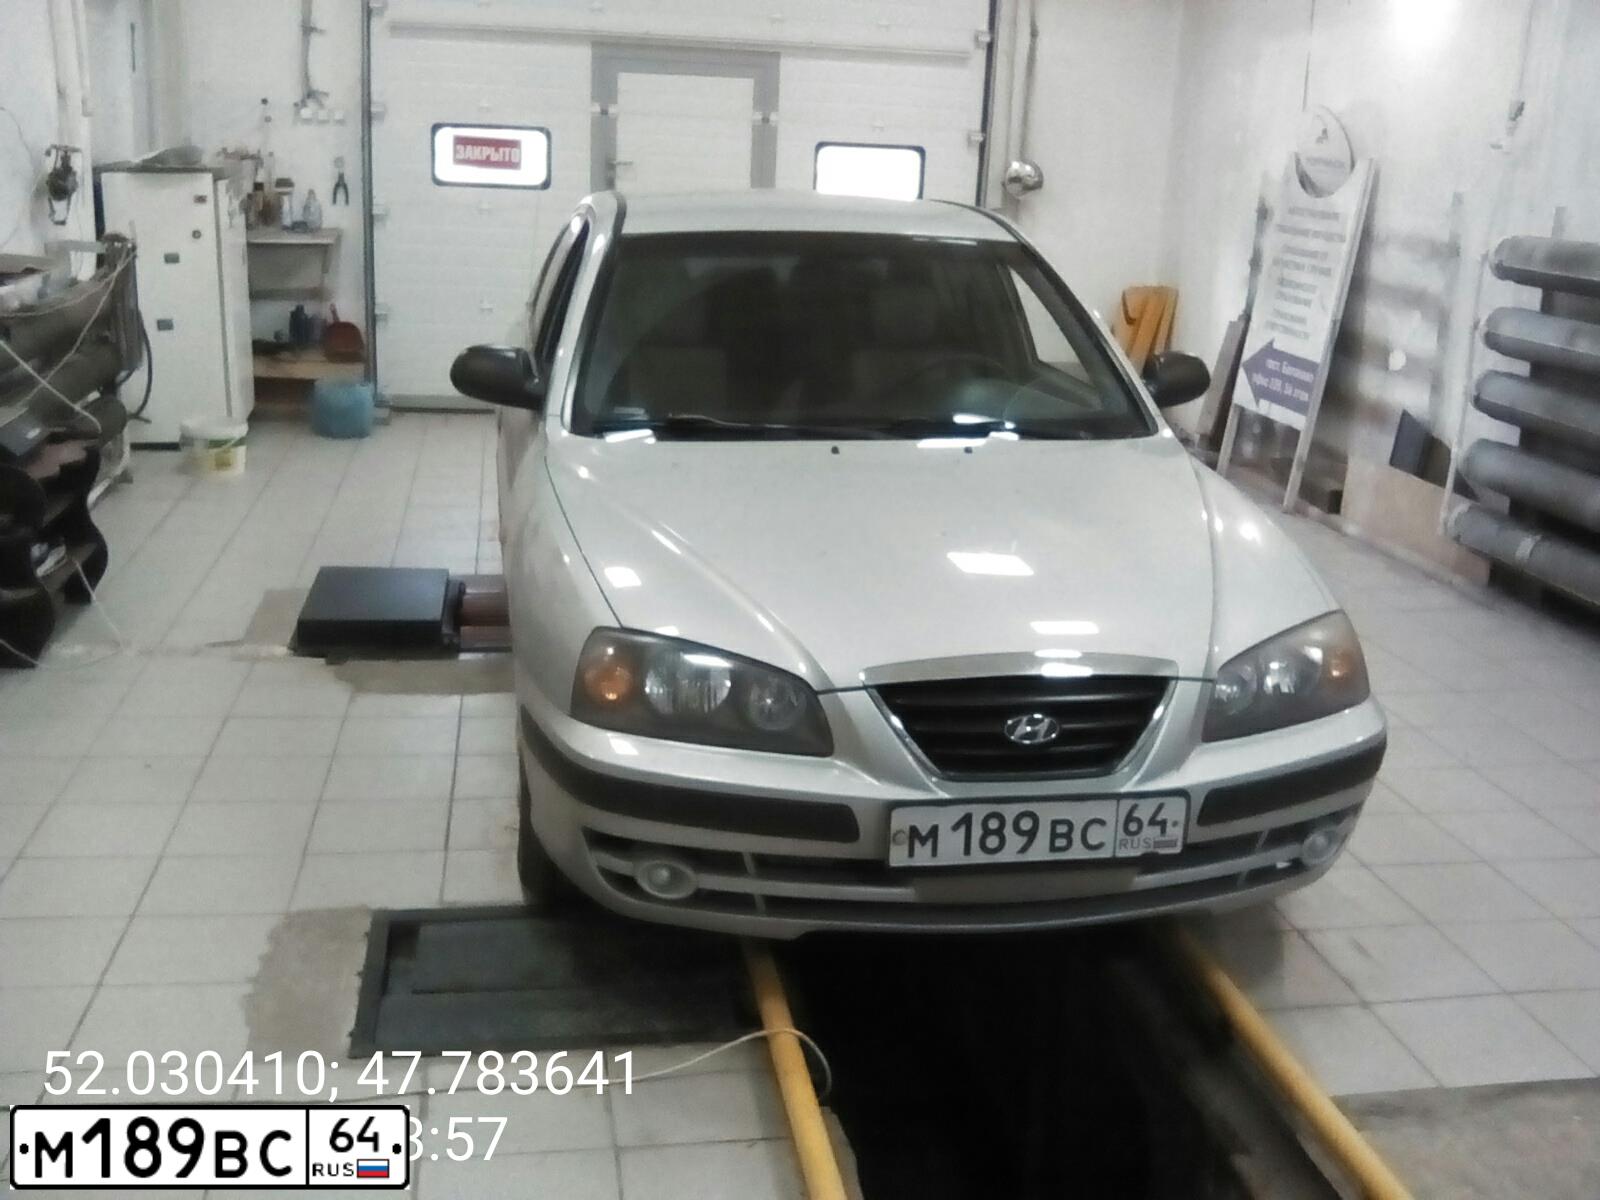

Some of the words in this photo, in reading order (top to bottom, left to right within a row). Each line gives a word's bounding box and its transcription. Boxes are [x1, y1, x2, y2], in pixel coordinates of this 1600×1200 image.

[456, 144, 520, 163] ЗАКРЫТО
[907, 810, 1107, 858] М189ВС
[1123, 803, 1168, 836] 64
[1119, 837, 1151, 850] RUS
